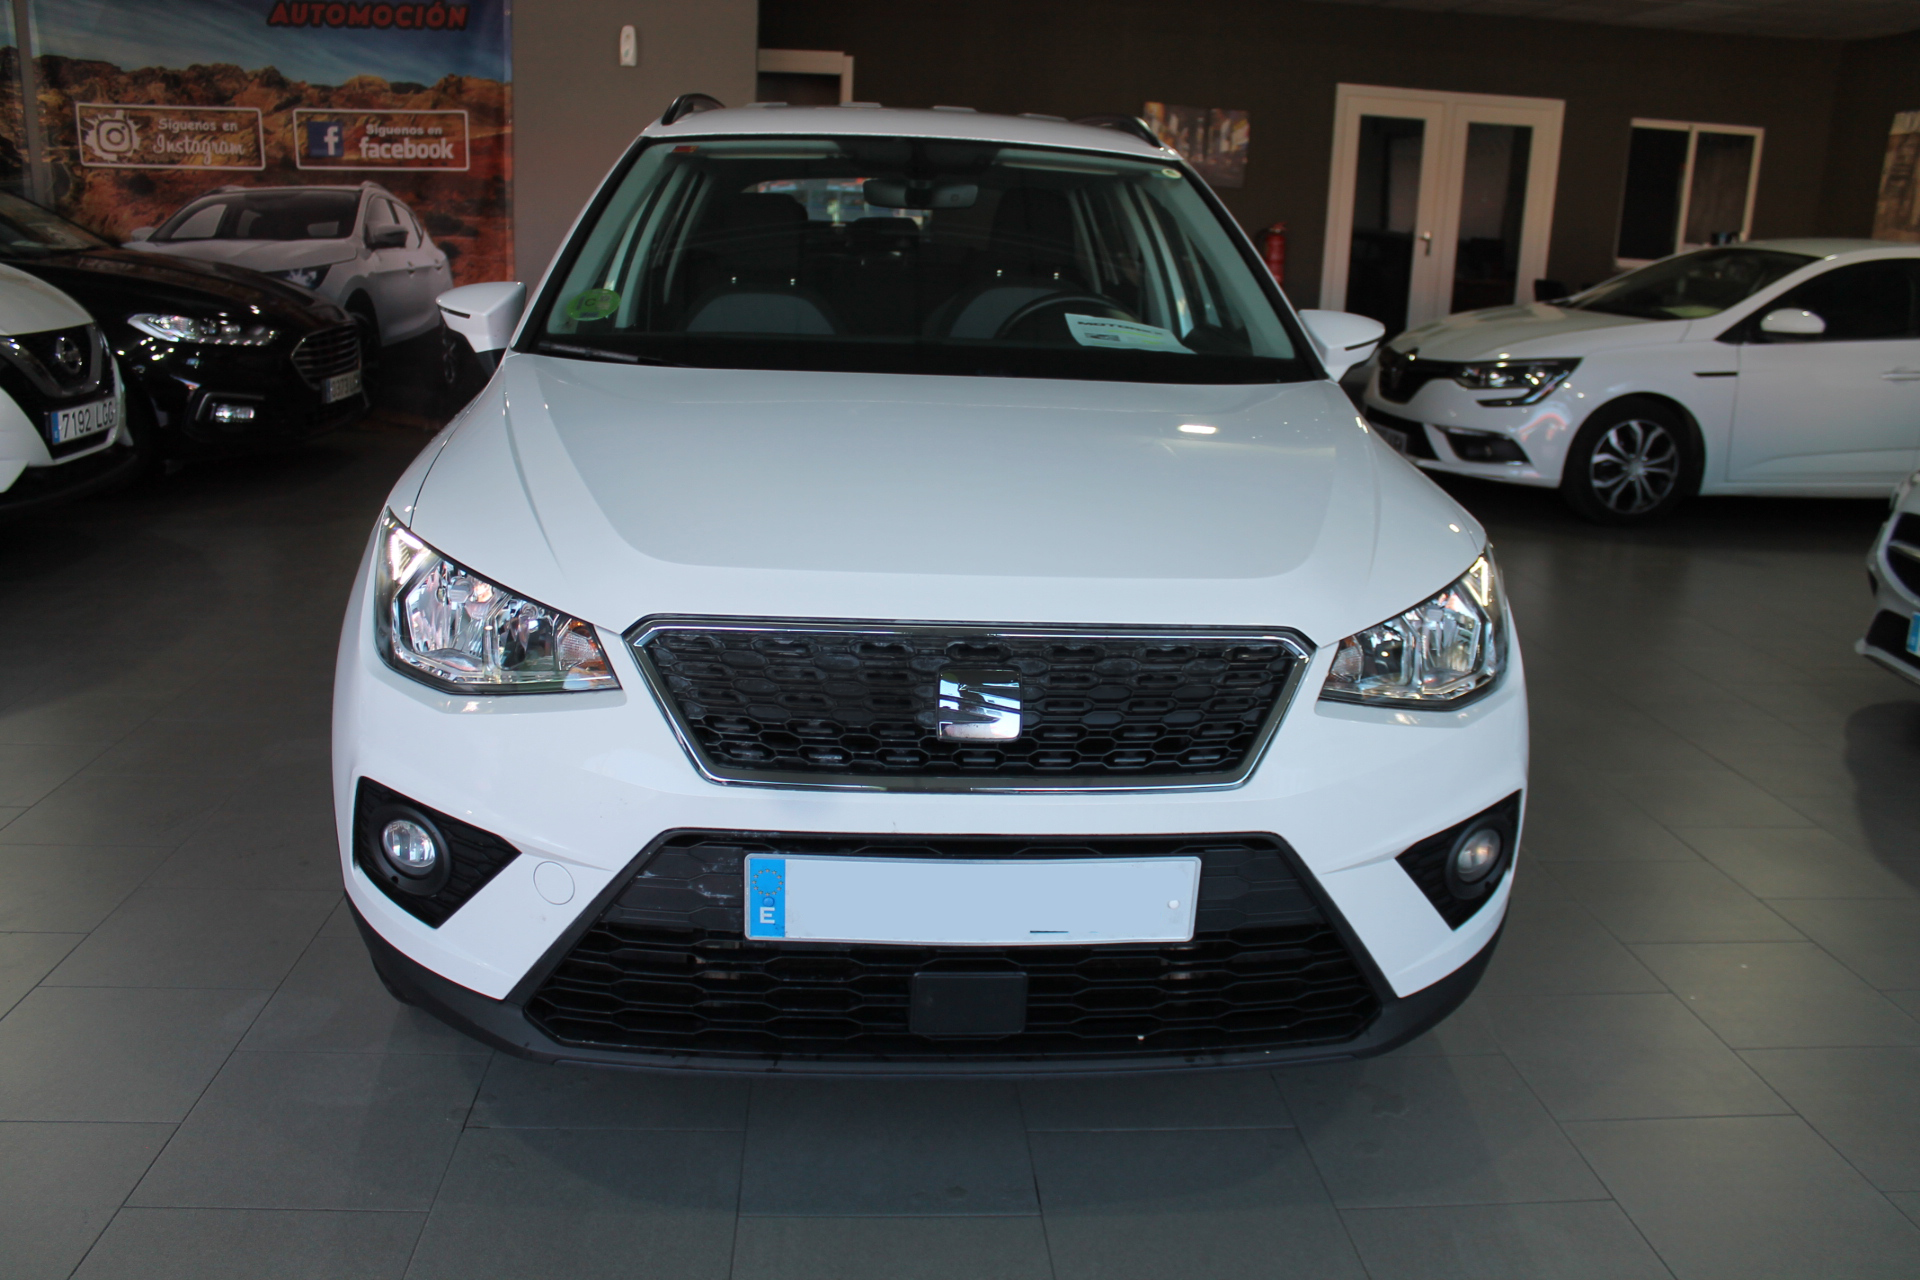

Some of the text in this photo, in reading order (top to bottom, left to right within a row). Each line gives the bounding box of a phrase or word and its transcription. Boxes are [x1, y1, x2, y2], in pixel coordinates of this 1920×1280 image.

[268, 1, 468, 29] AUTOMOCIÓN
[222, 122, 239, 131] en
[427, 126, 443, 135] en
[152, 134, 245, 165] Instagram
[358, 136, 455, 160] facebook
[62, 401, 114, 438] 7192 LGG
[759, 906, 776, 924] E
